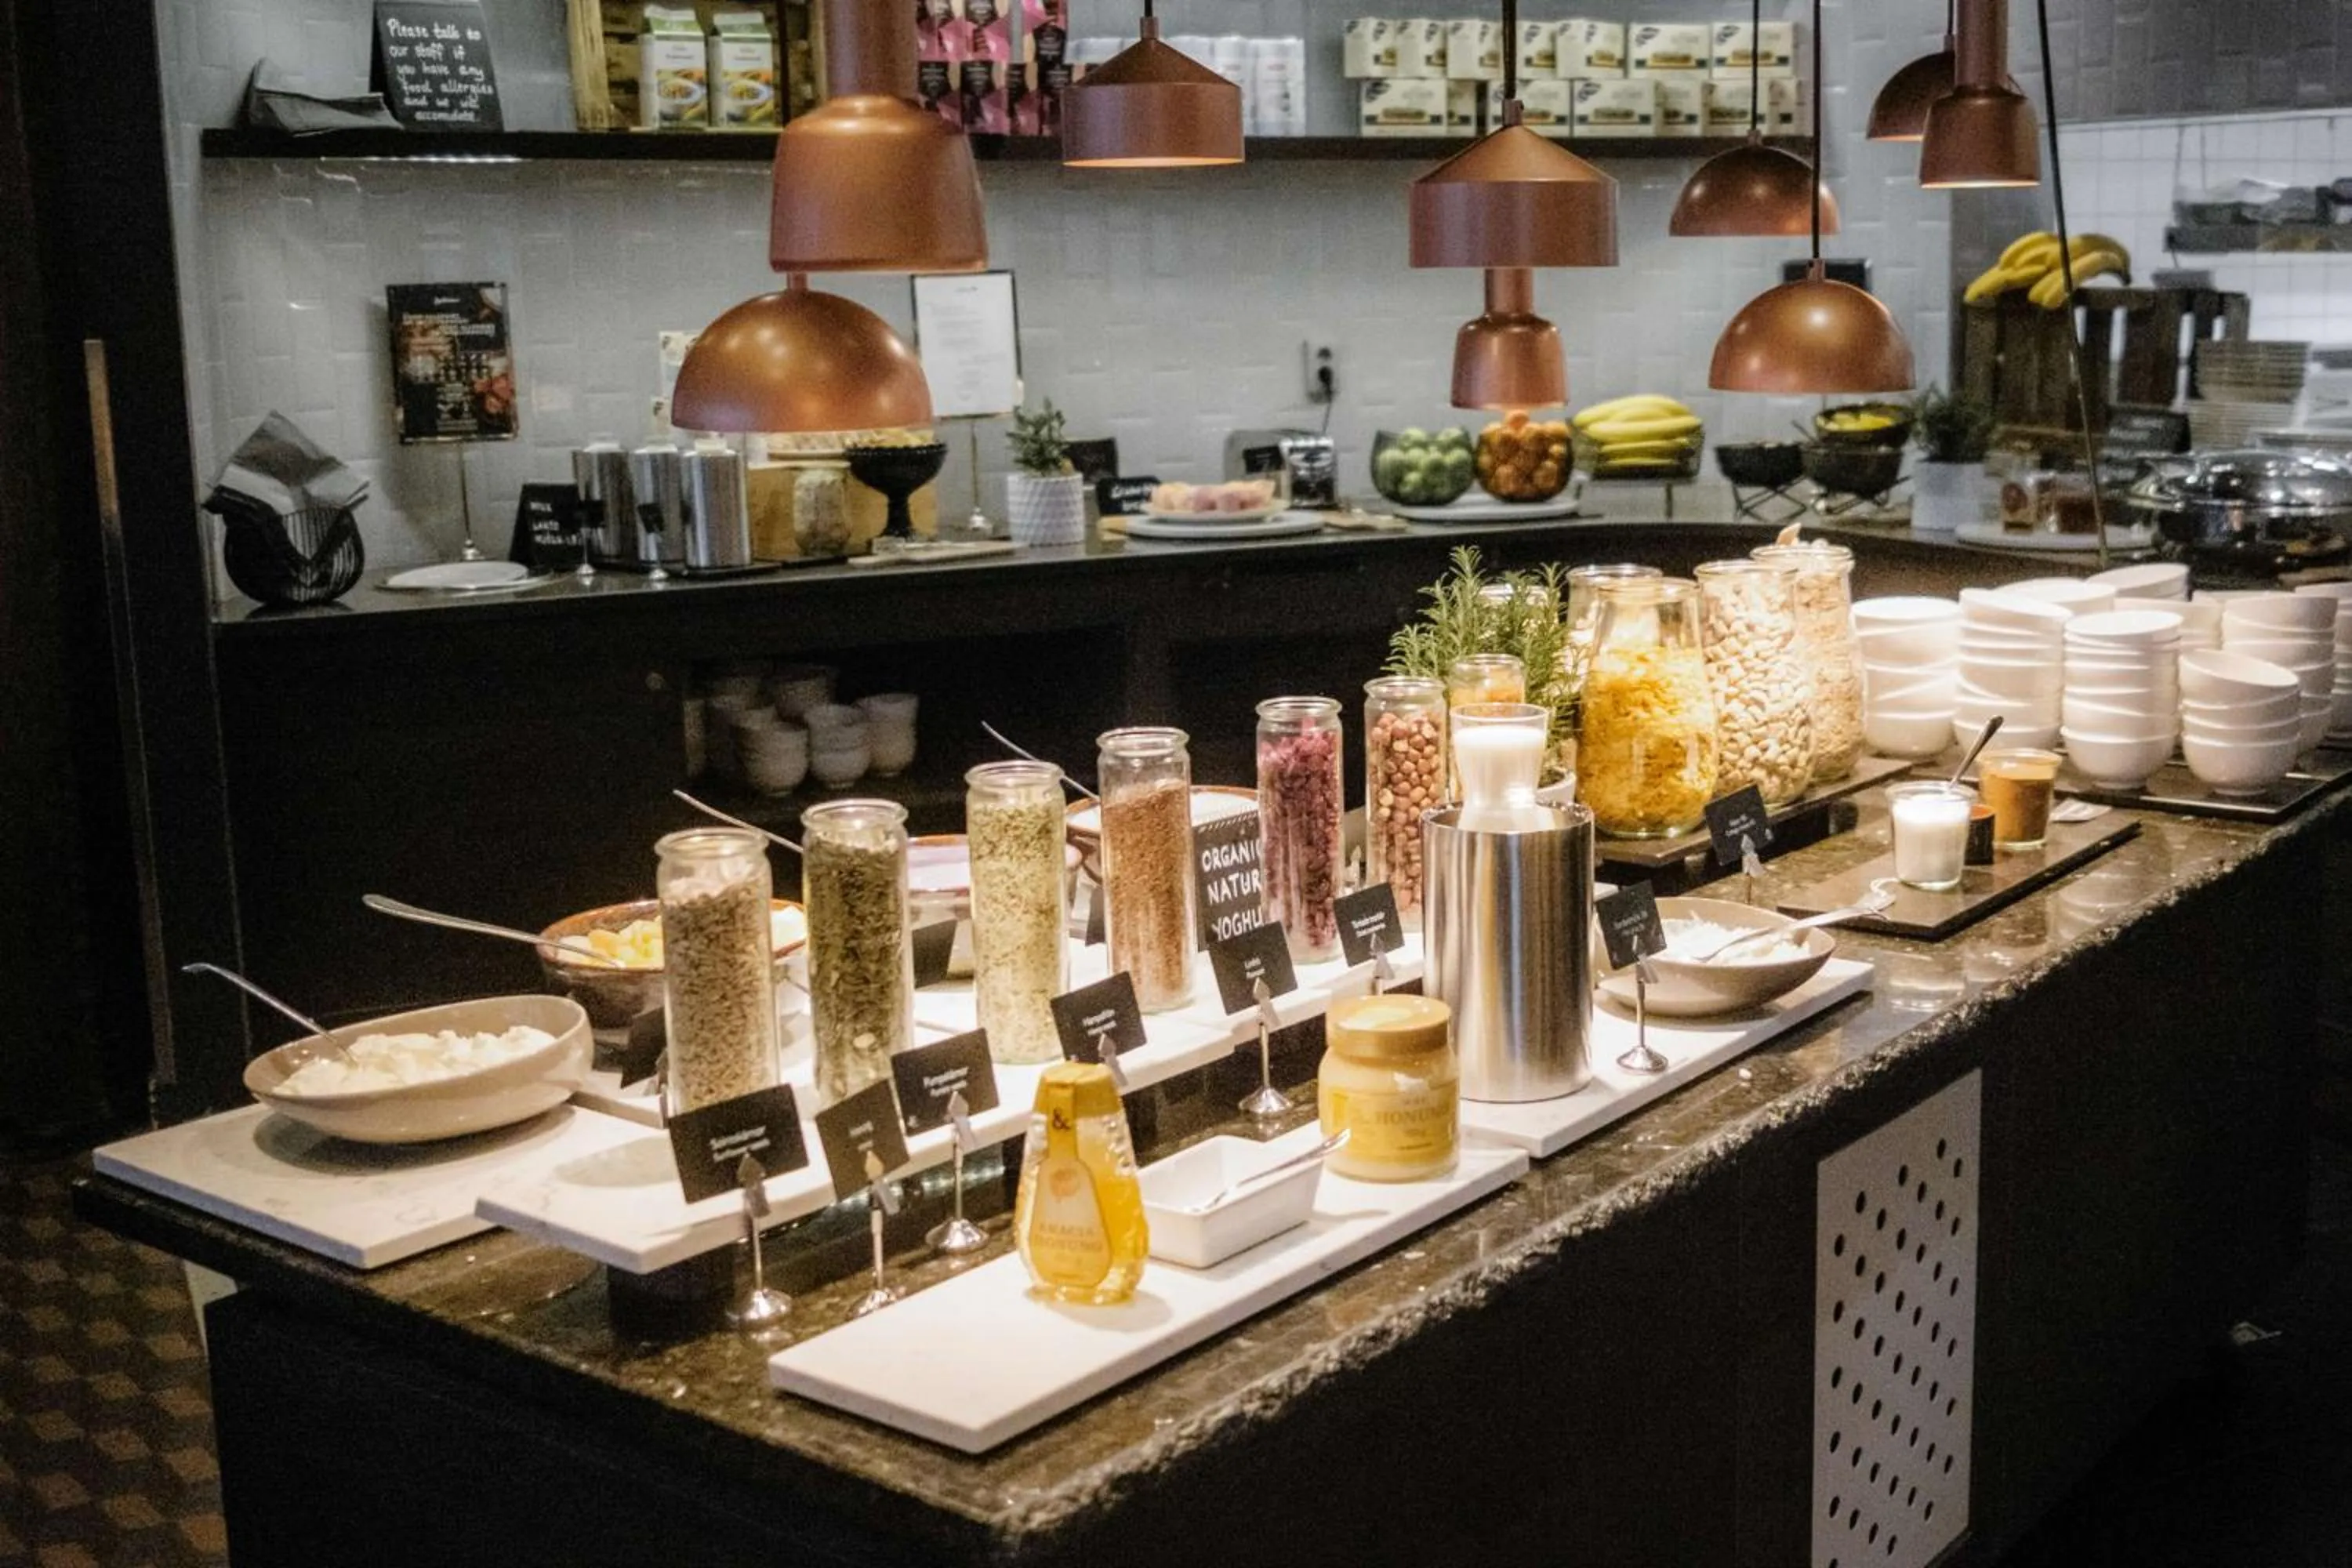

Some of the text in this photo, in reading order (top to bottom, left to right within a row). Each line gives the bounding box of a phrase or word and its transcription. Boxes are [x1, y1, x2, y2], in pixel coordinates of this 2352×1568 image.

[387, 18, 481, 40] Please talk to
[389, 45, 408, 57] our
[422, 61, 449, 75] have
[459, 65, 485, 82] any
